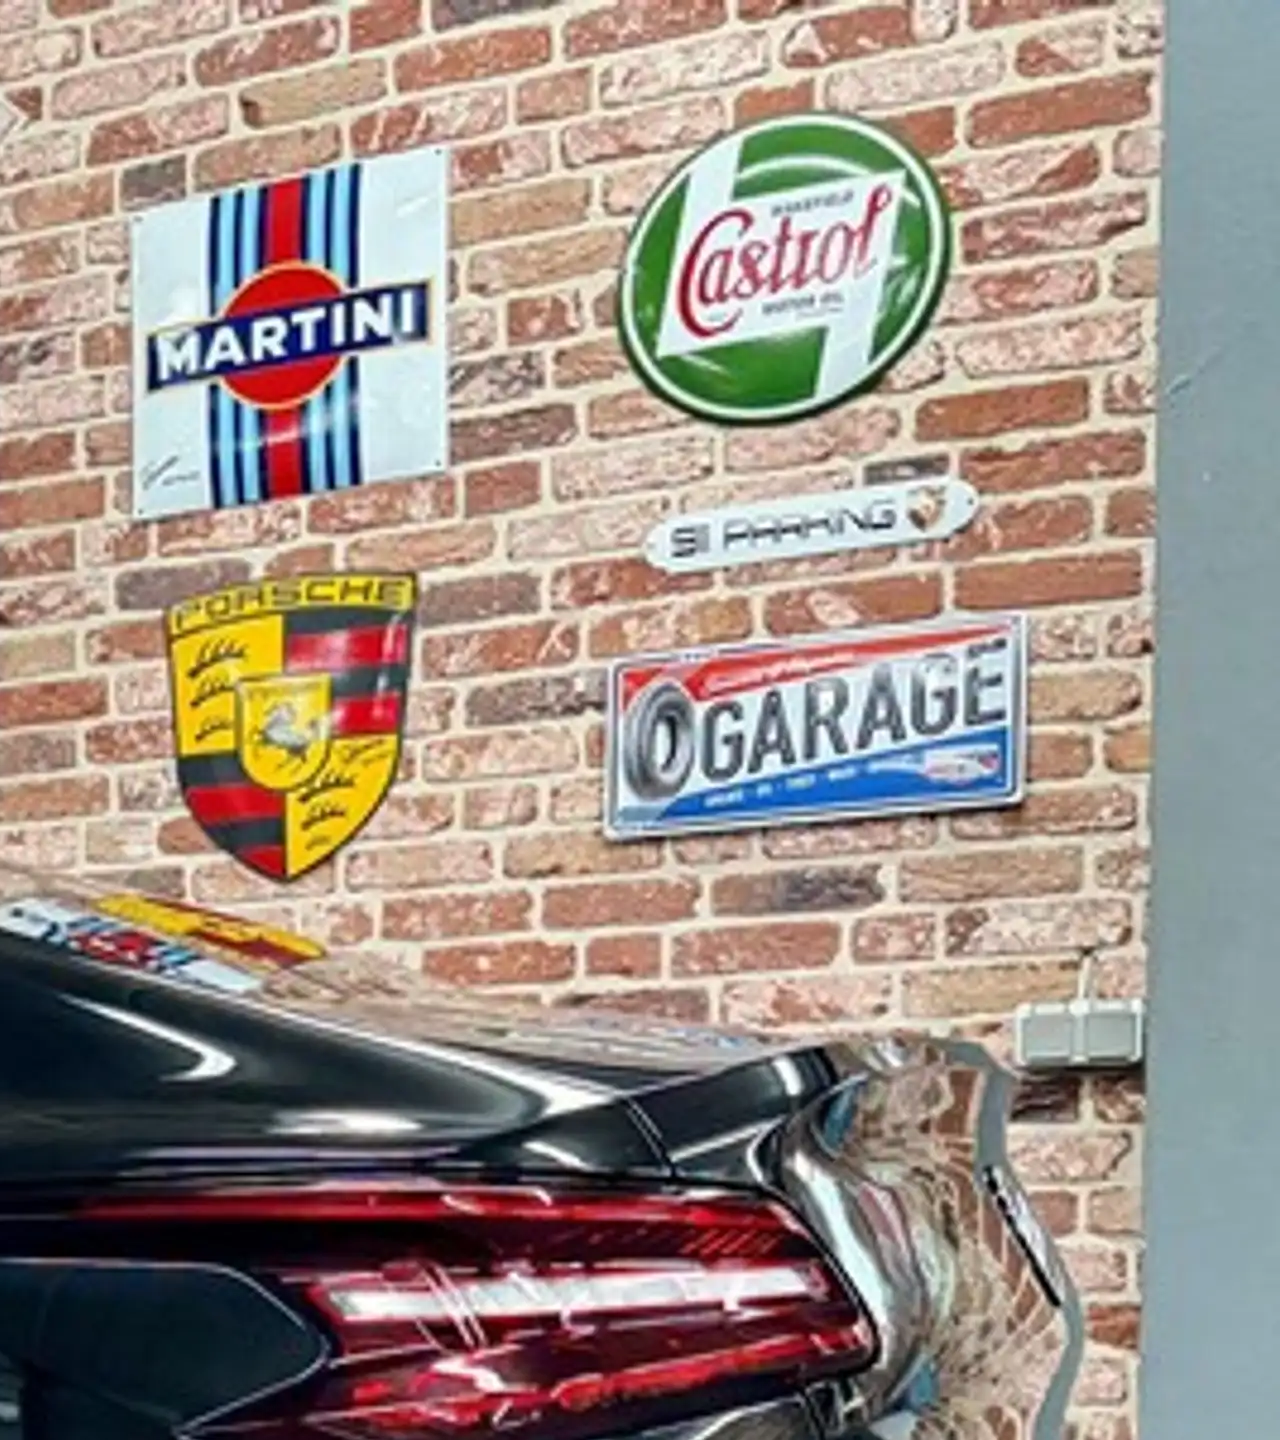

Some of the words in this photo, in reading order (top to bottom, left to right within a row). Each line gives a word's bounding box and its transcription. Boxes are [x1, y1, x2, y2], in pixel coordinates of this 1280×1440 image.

[677, 184, 892, 338] Castrol
[159, 289, 413, 381] MARTINI
[172, 578, 409, 635] PORSCHE
[701, 638, 1007, 782] GARAGE
